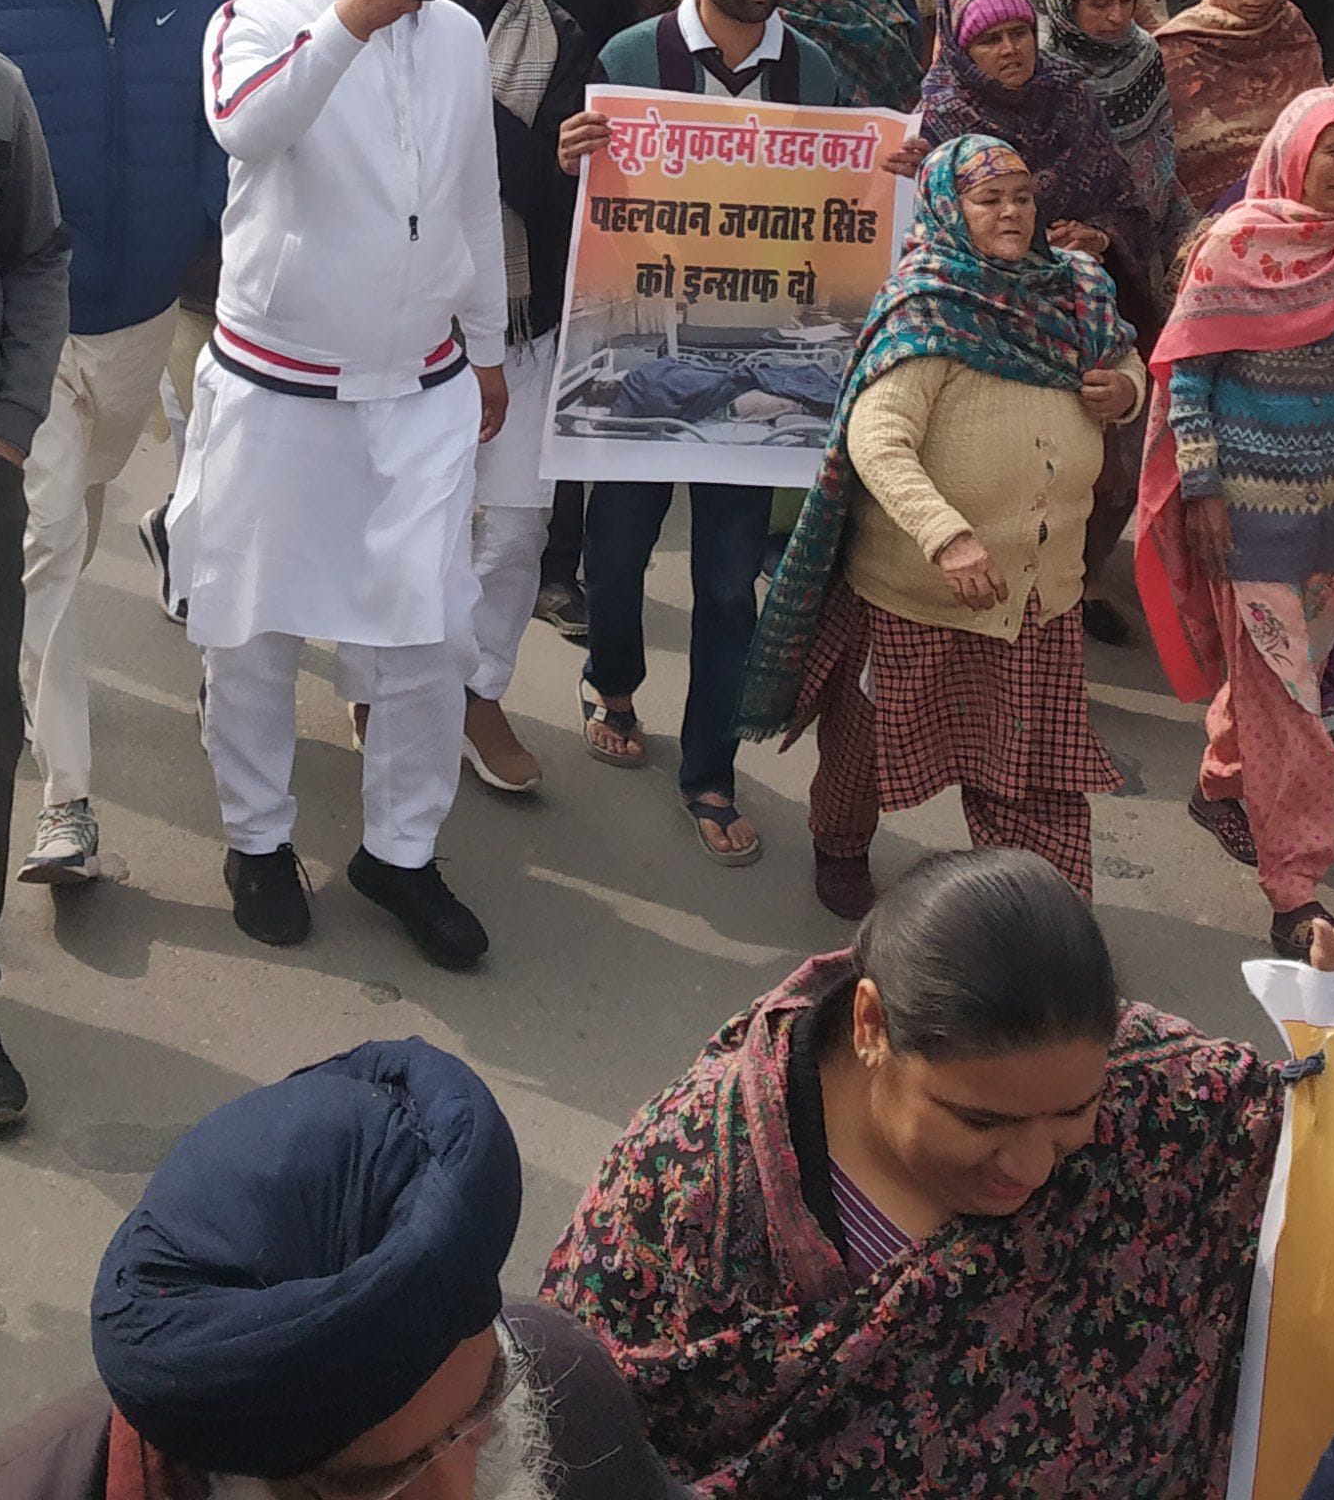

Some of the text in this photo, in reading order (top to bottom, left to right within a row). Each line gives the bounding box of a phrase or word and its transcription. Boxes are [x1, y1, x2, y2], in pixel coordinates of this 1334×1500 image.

[611, 110, 663, 172] झूठे
[665, 116, 759, 175] मुकदमे
[822, 124, 879, 170] करो
[590, 196, 879, 244] पहलवान जगतार सिंह
[636, 253, 817, 305] को इन्साफ दो
